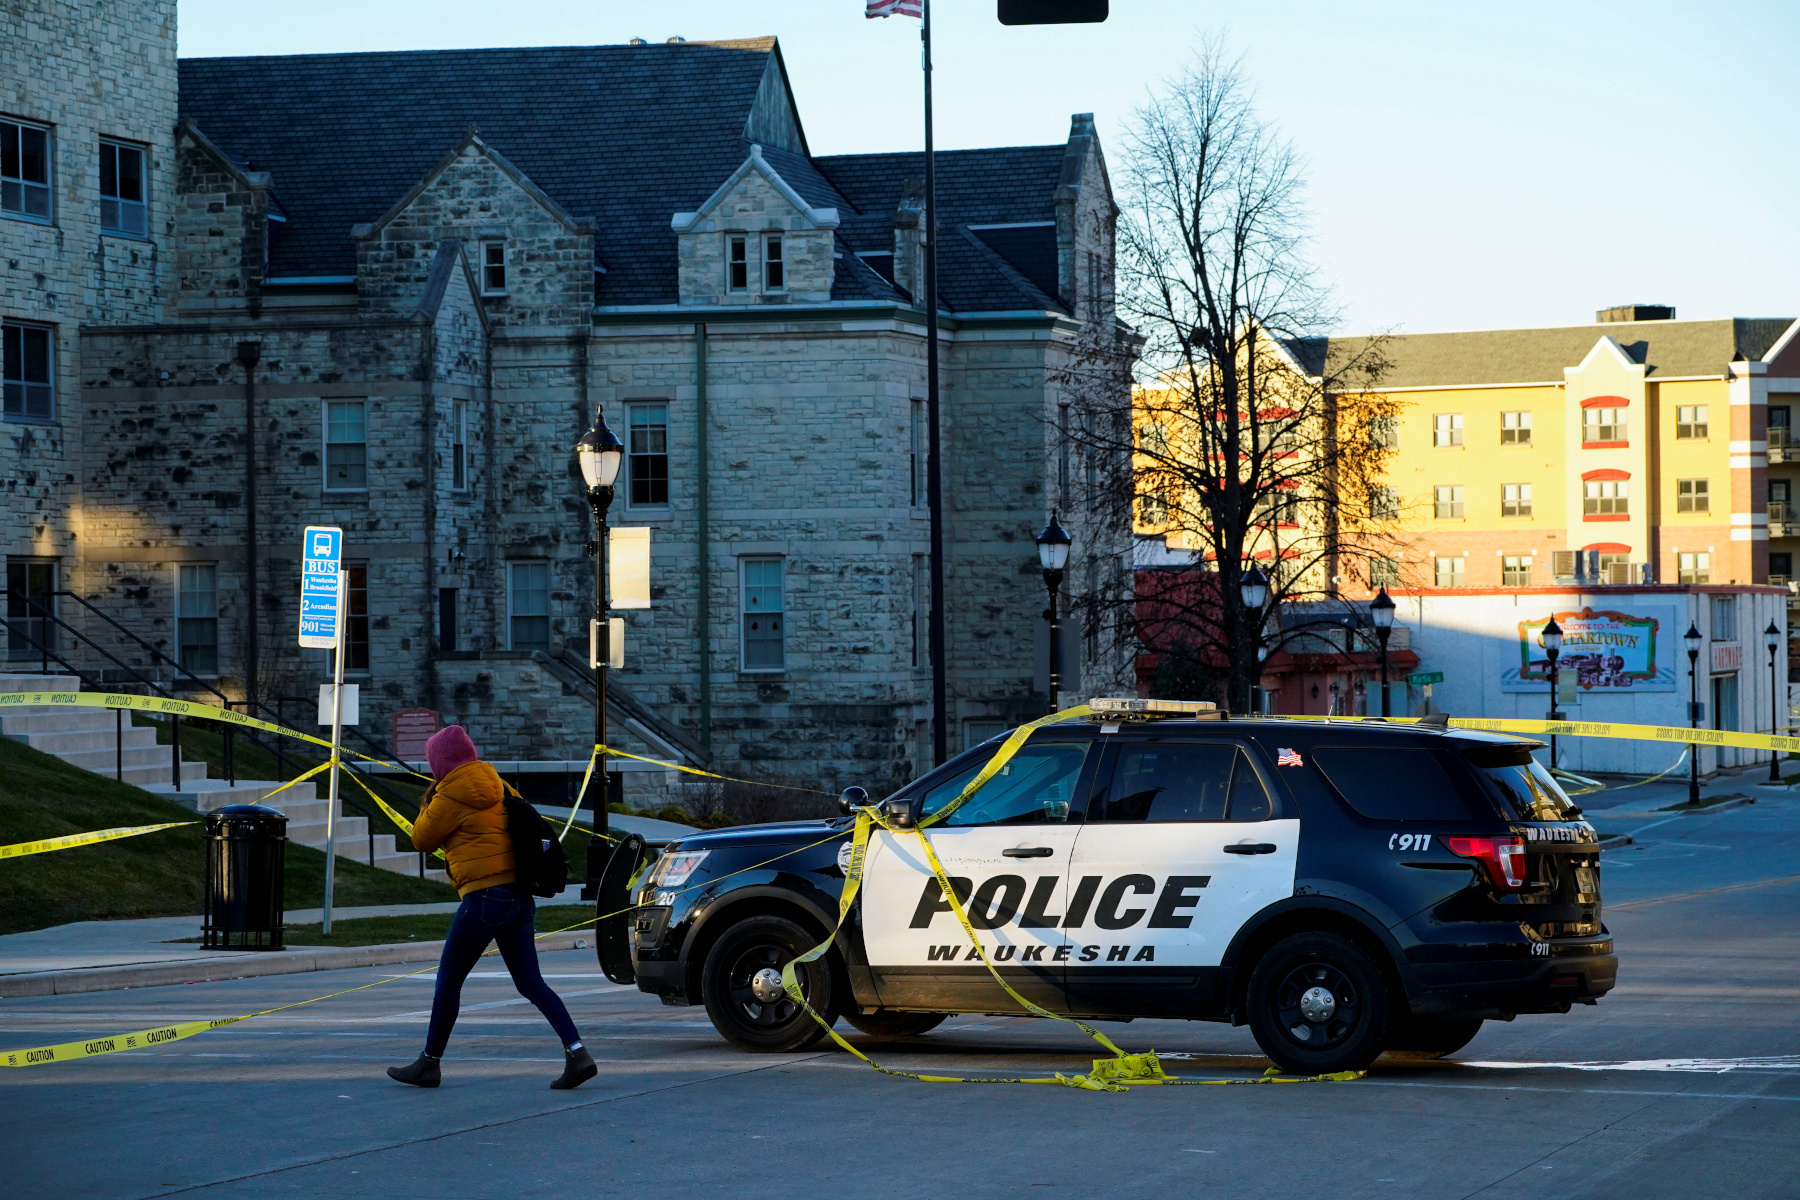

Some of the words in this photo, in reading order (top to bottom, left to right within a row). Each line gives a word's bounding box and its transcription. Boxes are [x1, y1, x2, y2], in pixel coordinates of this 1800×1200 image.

[308, 561, 335, 574] BUS
[304, 579, 309, 590] 1
[303, 599, 309, 611] 2
[302, 620, 319, 632] 901
[1527, 827, 1580, 841] WAUKESHA
[1399, 834, 1432, 851] 911
[658, 892, 675, 906] 20
[909, 874, 1211, 930] POLICE
[927, 945, 1155, 962] WAUKESHA
[1534, 943, 1549, 956] 911
[146, 1028, 177, 1043] CAUTION
[85, 1040, 115, 1054] CAUTION
[26, 1049, 54, 1063] CAUTION
